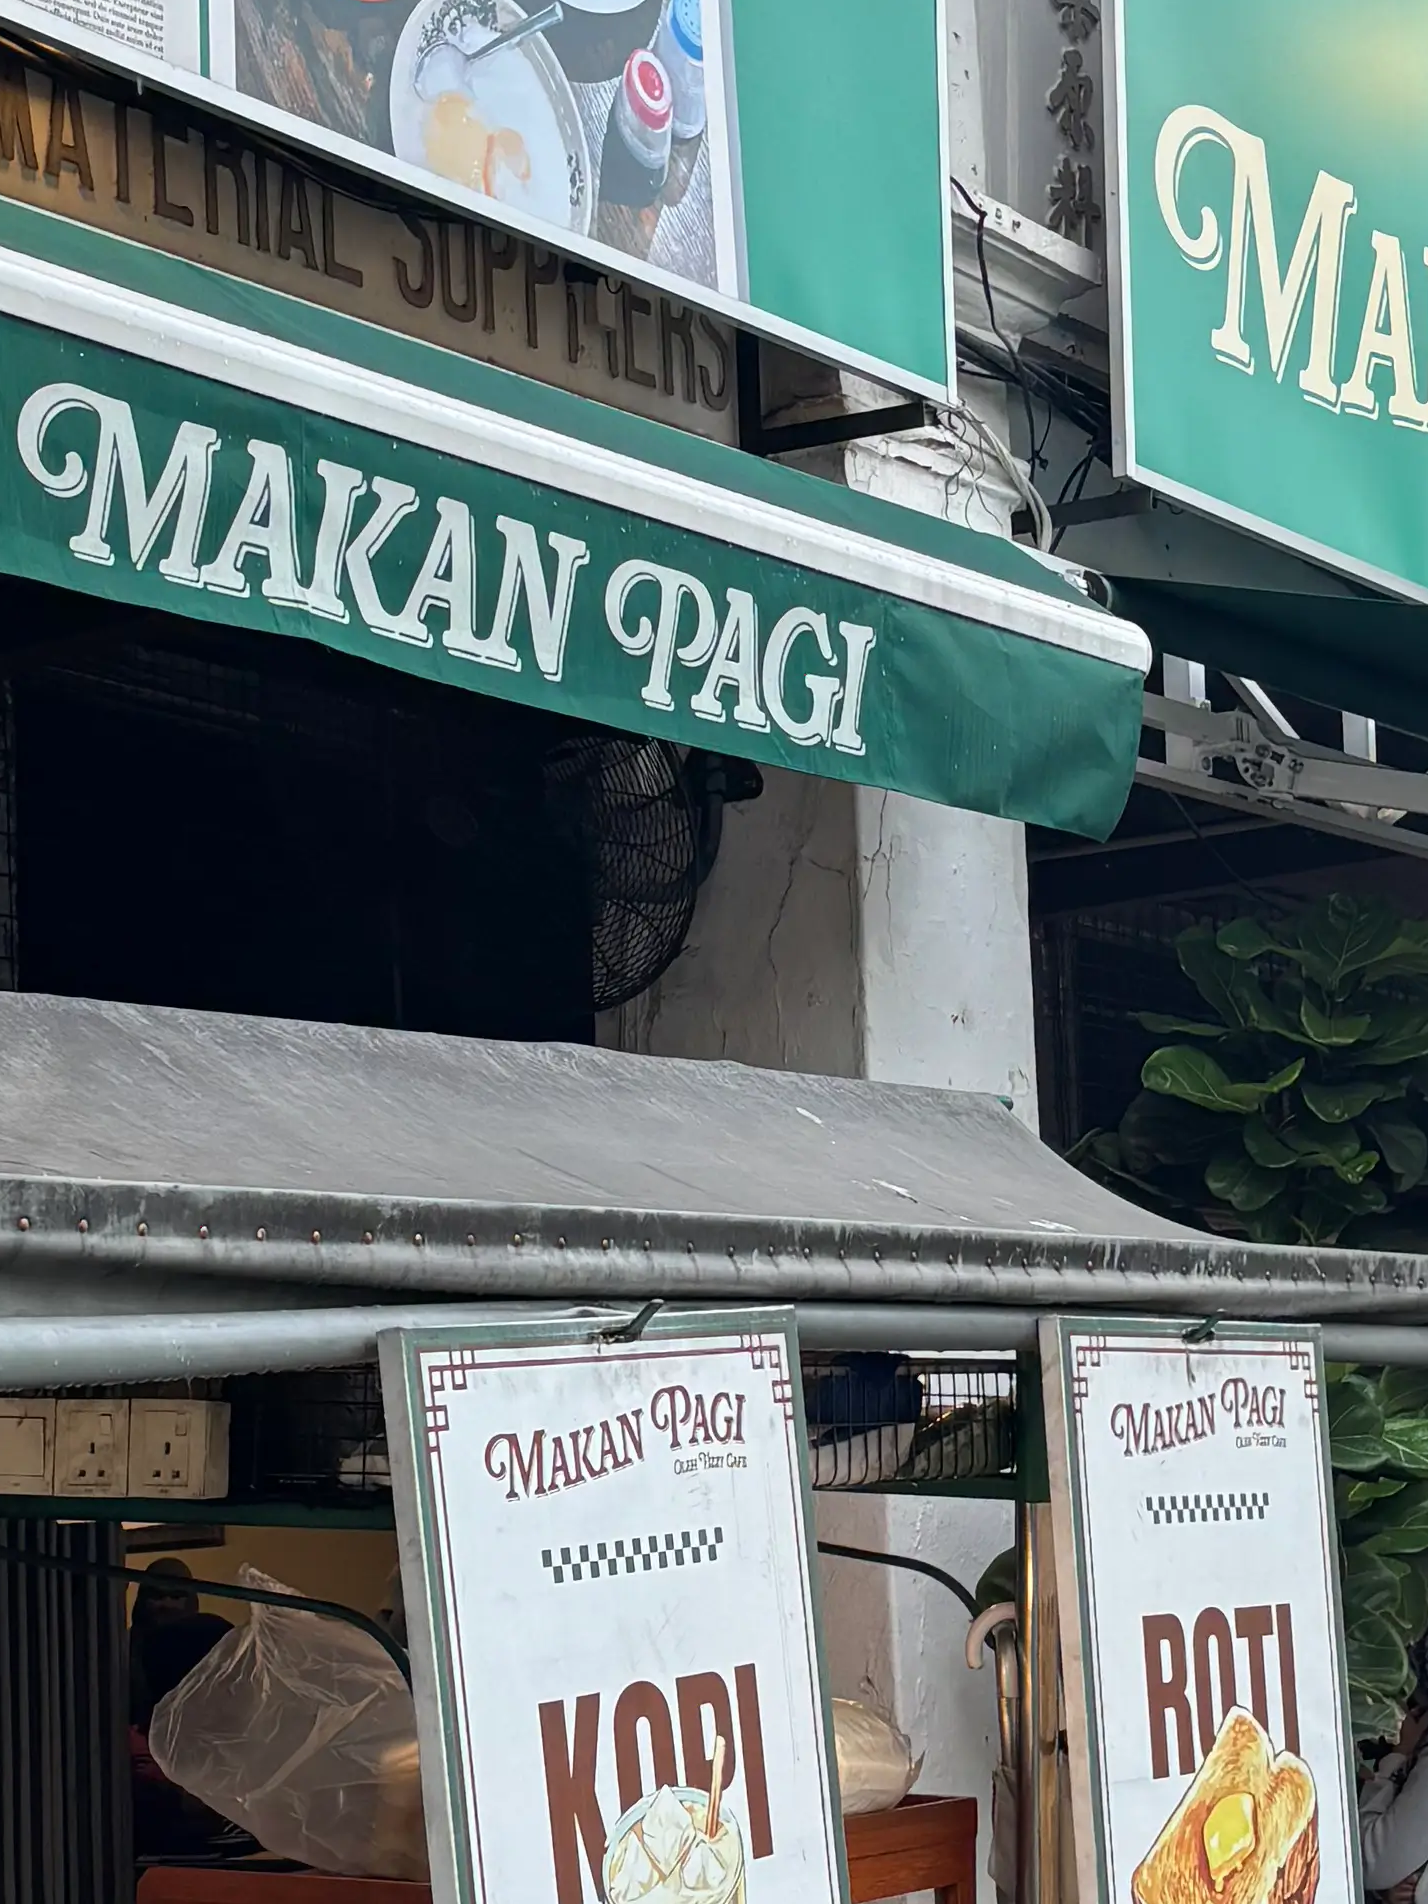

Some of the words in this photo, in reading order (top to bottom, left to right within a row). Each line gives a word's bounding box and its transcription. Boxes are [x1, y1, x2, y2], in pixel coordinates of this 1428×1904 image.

[16, 381, 590, 684] MAKAN
[604, 558, 876, 756] PAGI
[483, 1407, 645, 1503] MAKAN
[650, 1384, 747, 1452] PAGI
[1110, 1392, 1217, 1458] MAKAN
[1220, 1377, 1287, 1430] PAGI
[1142, 1602, 1302, 1781] ROTI
